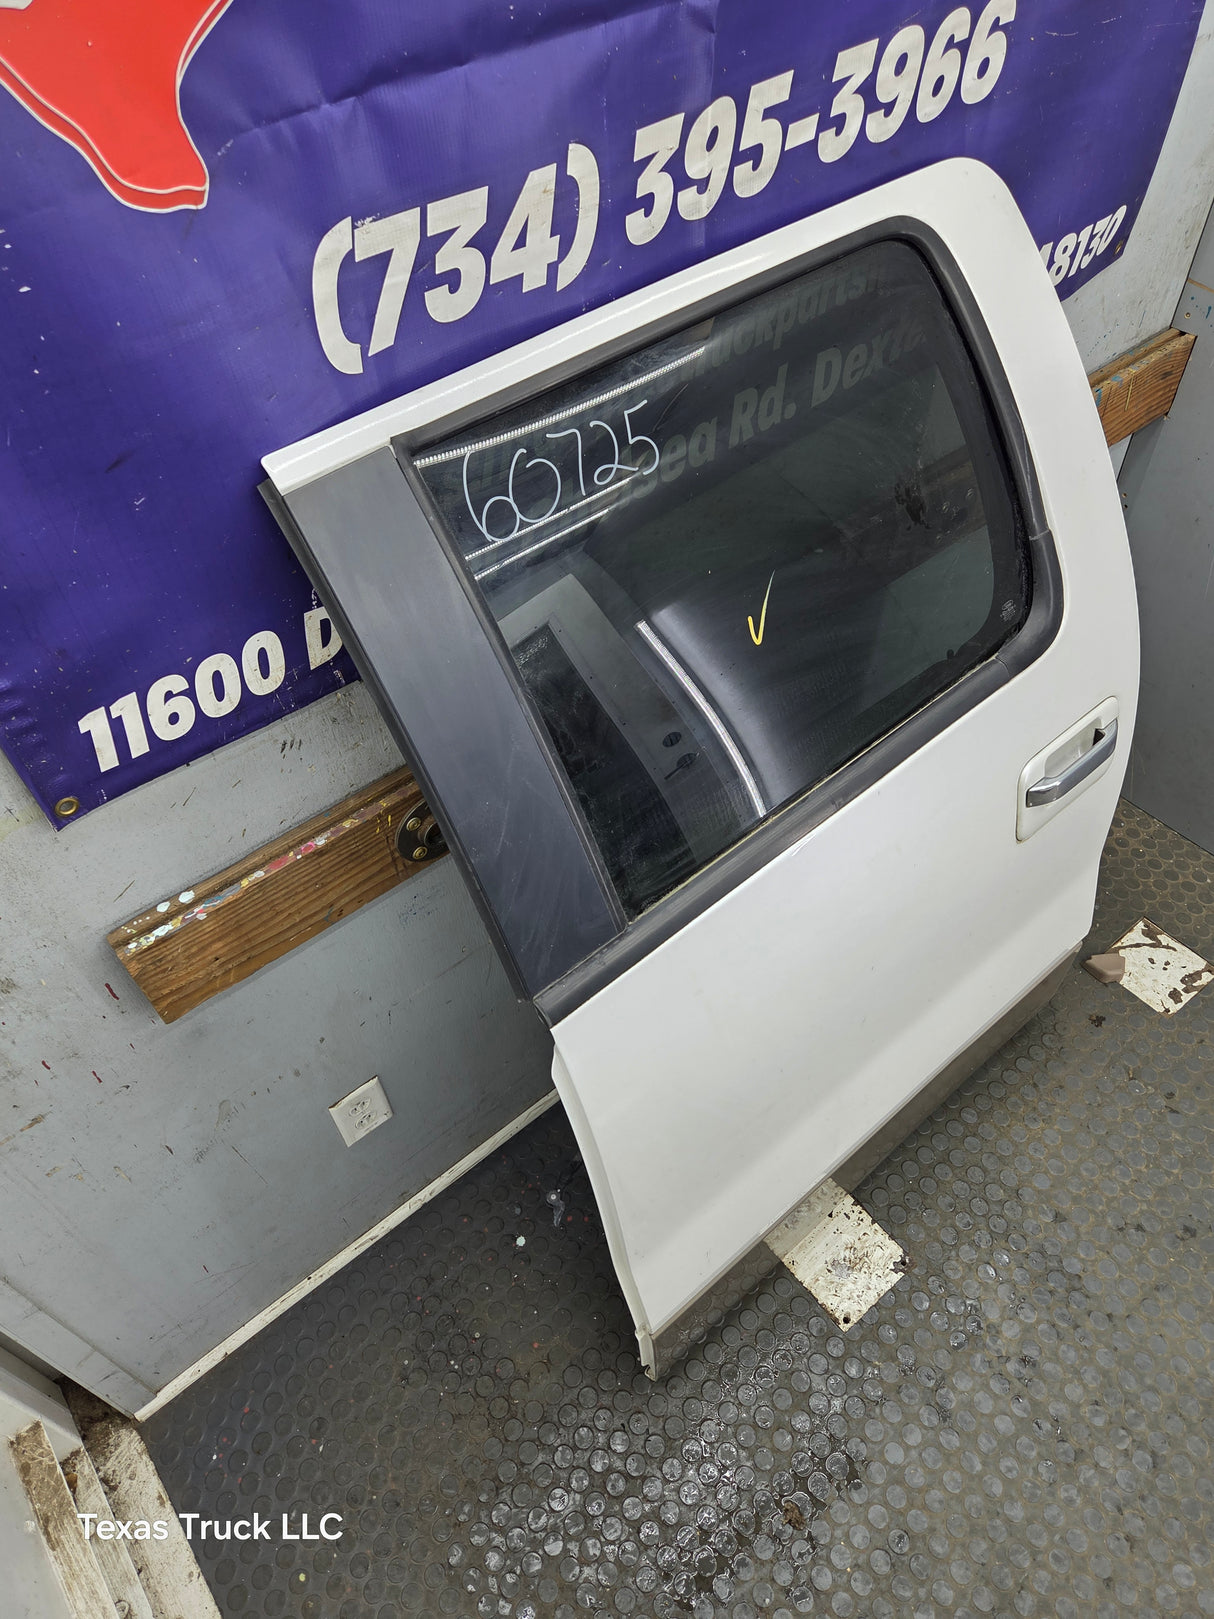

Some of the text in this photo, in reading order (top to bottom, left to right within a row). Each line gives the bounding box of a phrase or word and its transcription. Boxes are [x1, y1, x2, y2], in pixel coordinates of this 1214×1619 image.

[312, 0, 1017, 375] (734) 395-3966
[77, 630, 286, 773] 11600
[303, 606, 343, 671] D
[728, 361, 797, 450] Rd.
[463, 399, 660, 542] 60725
